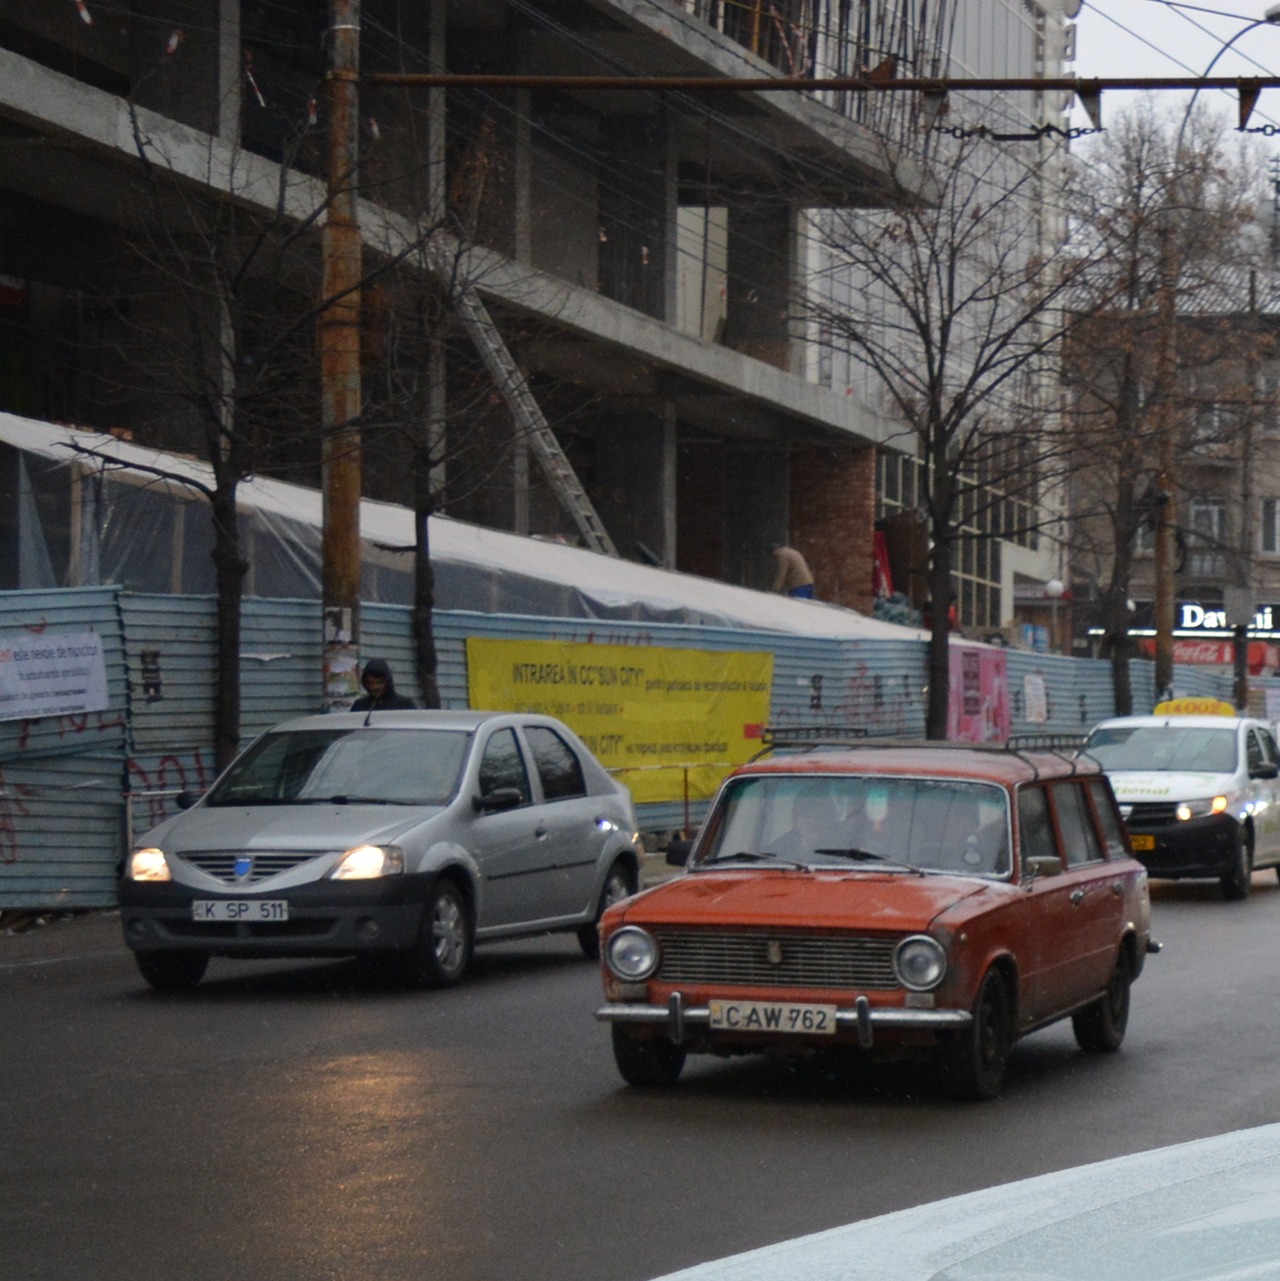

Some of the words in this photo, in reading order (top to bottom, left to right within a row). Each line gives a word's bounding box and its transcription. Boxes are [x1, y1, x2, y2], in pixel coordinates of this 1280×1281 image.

[205, 903, 216, 918] K
[226, 903, 249, 918] SP
[260, 903, 284, 918] 511
[726, 1006, 740, 1026] C
[746, 1007, 783, 1029] AW
[789, 1008, 827, 1030] 762
